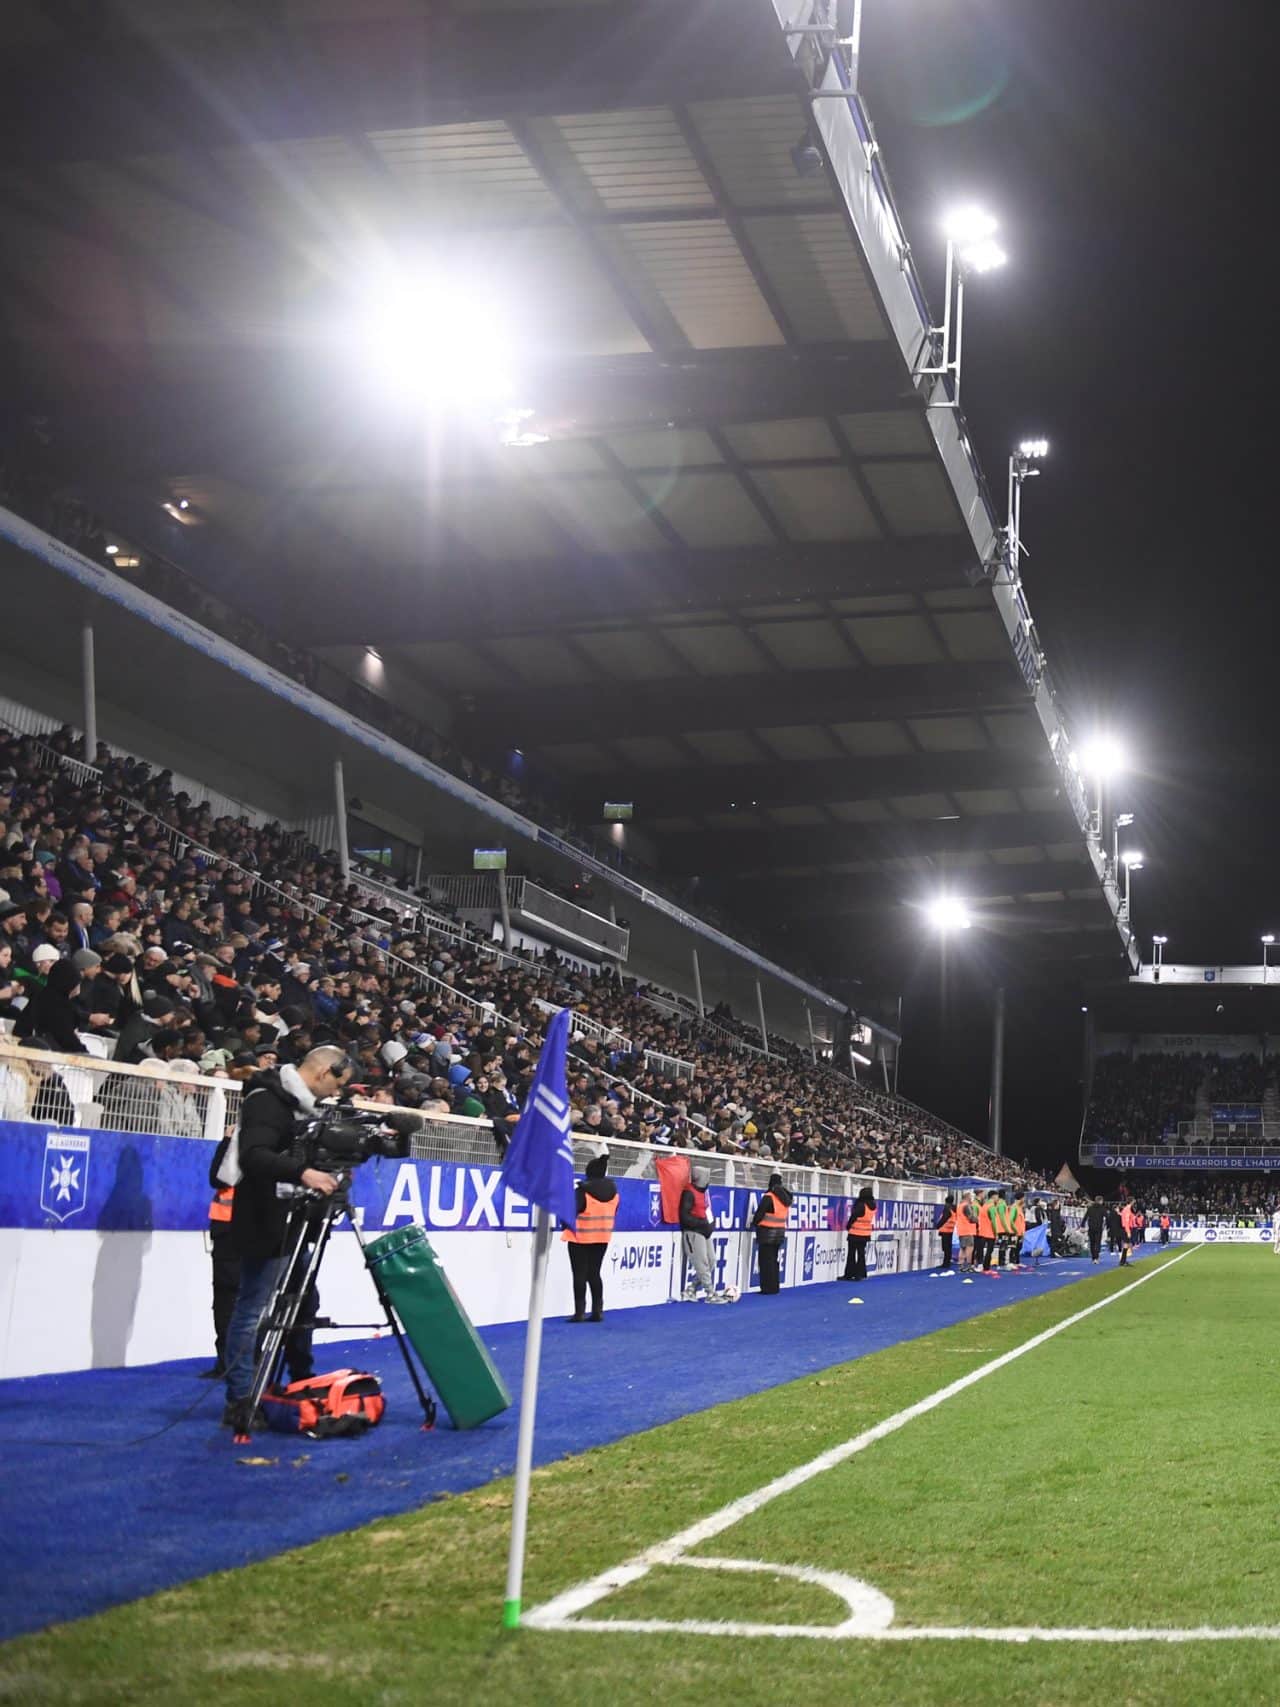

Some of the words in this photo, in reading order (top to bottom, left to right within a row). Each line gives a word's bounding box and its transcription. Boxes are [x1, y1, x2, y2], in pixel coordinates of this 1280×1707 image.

[1104, 1156, 1135, 1167] OAH
[1145, 1158, 1177, 1166] OFFICE
[1178, 1158, 1229, 1166] AUXERROIS
[1231, 1159, 1243, 1167] DE
[891, 1203, 934, 1229] AUXERRE
[620, 1245, 663, 1270] ADVISE
